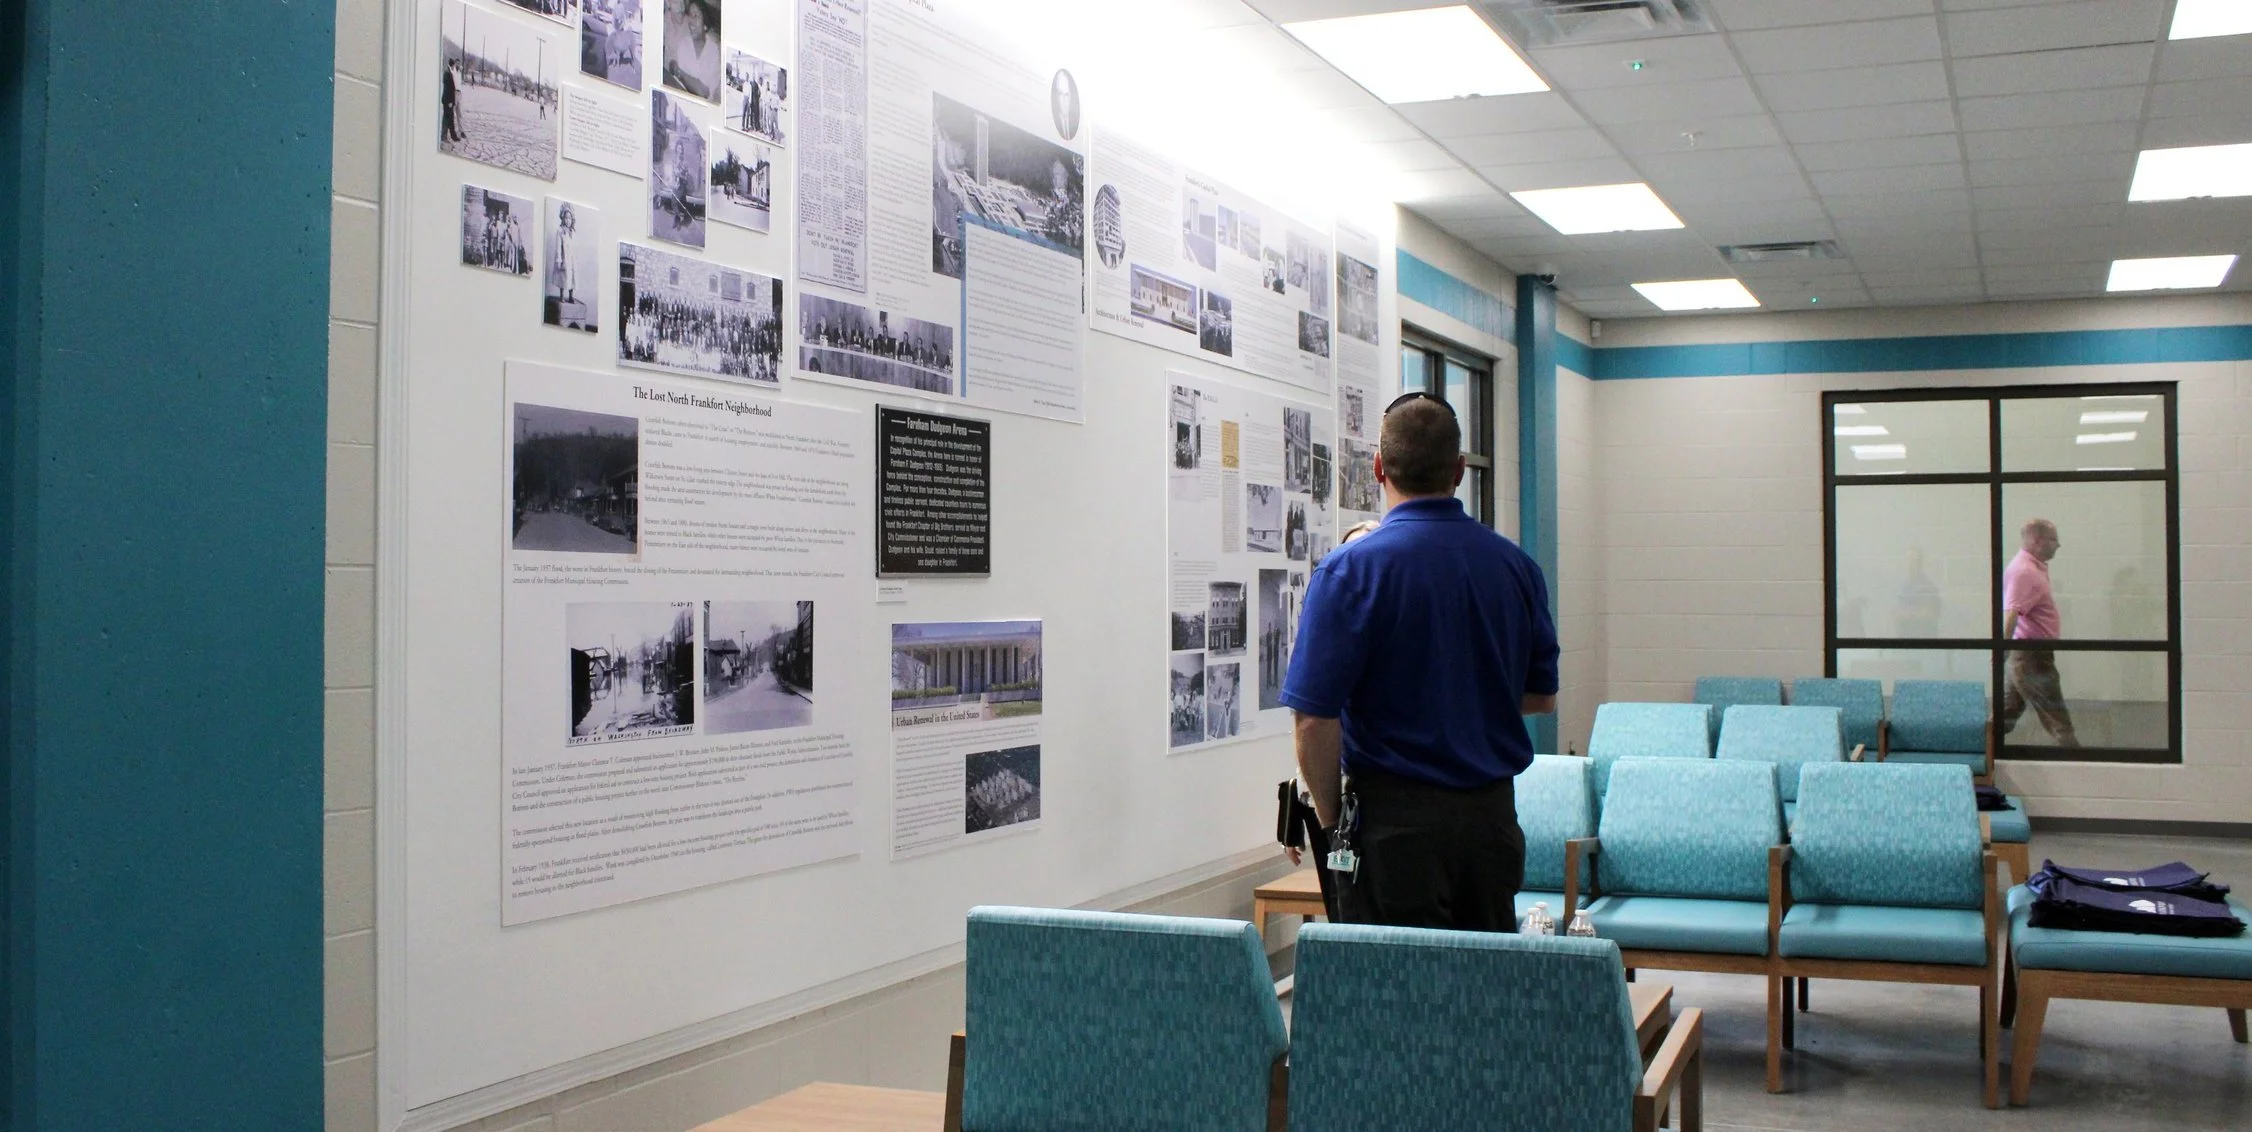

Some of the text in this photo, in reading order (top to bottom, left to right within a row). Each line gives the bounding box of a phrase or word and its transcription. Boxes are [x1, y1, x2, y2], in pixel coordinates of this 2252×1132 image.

[633, 385, 771, 418] The Lost North Frankfort Neighborhood
[906, 416, 967, 436] Farnham Dudgeon Arena
[896, 716, 912, 727] Urban
[914, 714, 933, 725] Renewal
[935, 714, 940, 722] in
[950, 711, 965, 721] United
[966, 710, 979, 720] States
